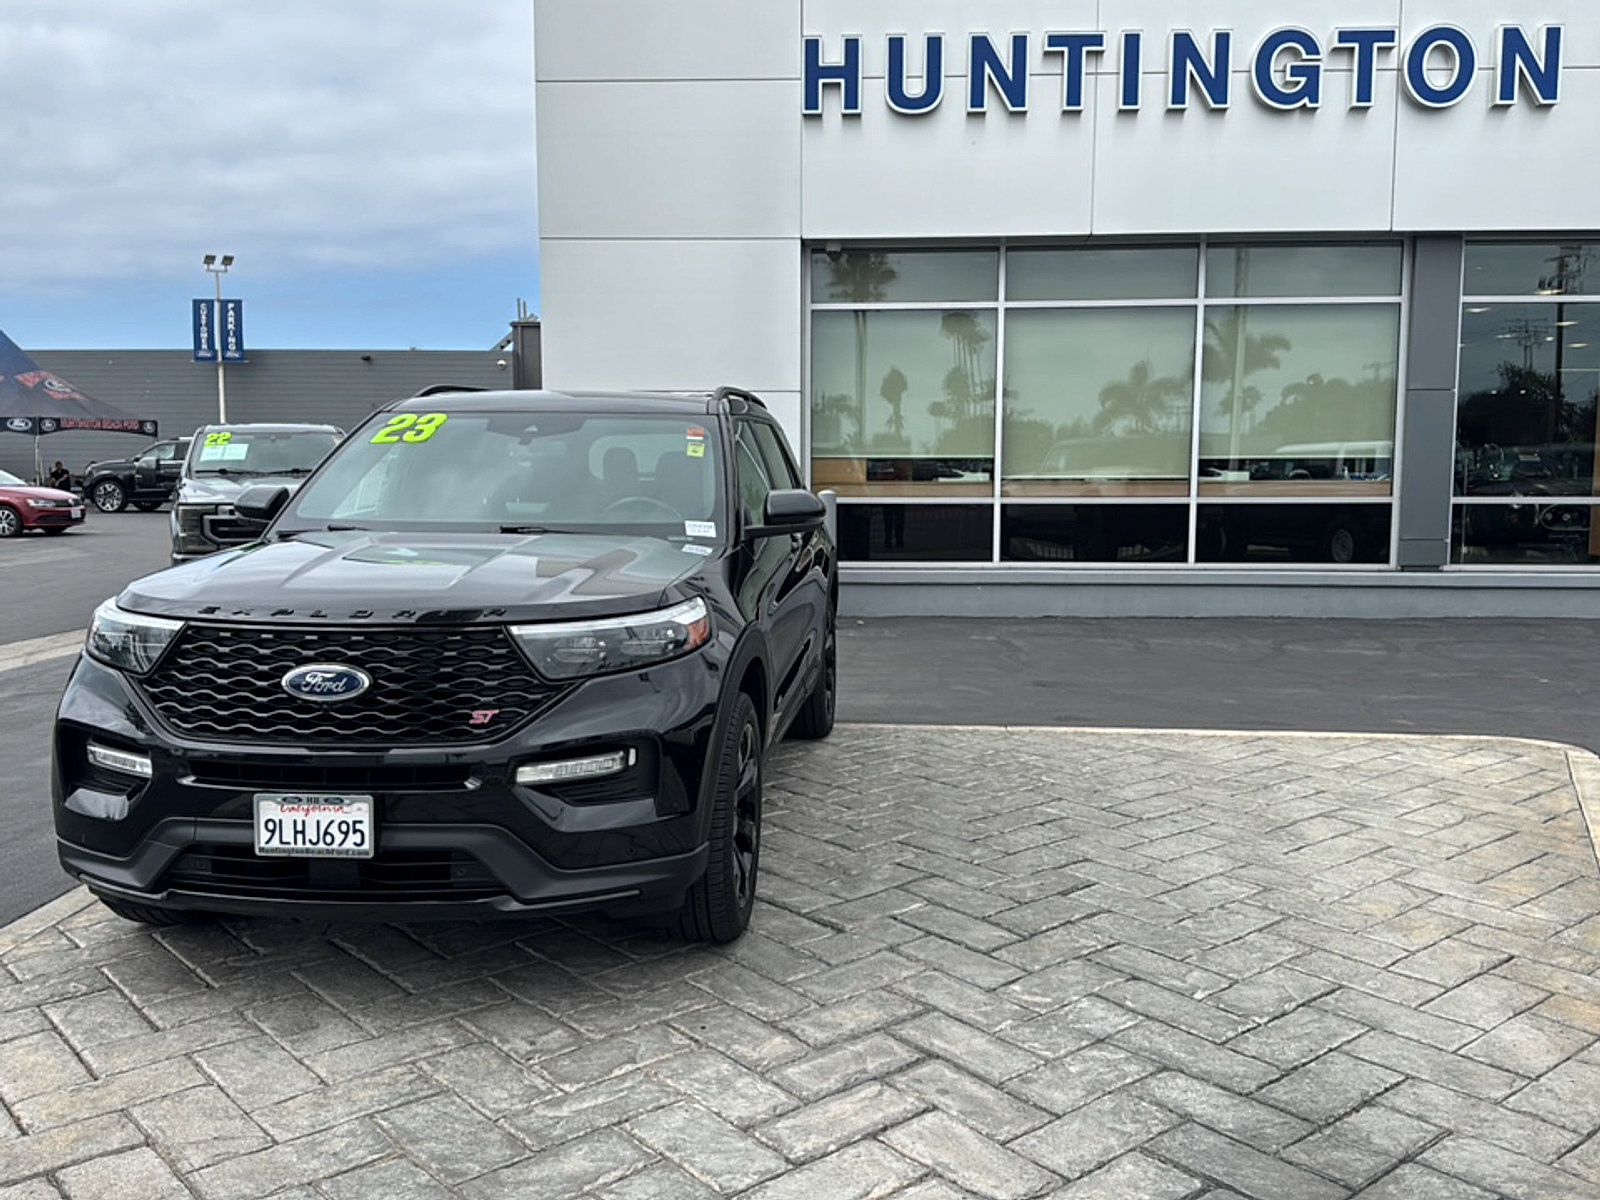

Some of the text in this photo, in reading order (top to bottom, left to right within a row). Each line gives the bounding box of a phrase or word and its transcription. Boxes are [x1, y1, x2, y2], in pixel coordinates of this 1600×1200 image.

[802, 25, 1562, 115] HUNTINGTON
[227, 303, 236, 350] PARKING
[205, 432, 232, 446] 22
[370, 413, 448, 444] 23
[302, 672, 347, 692] Ford
[469, 709, 499, 724] ST
[280, 804, 345, 816] California
[264, 818, 365, 847] 9LHJ695
